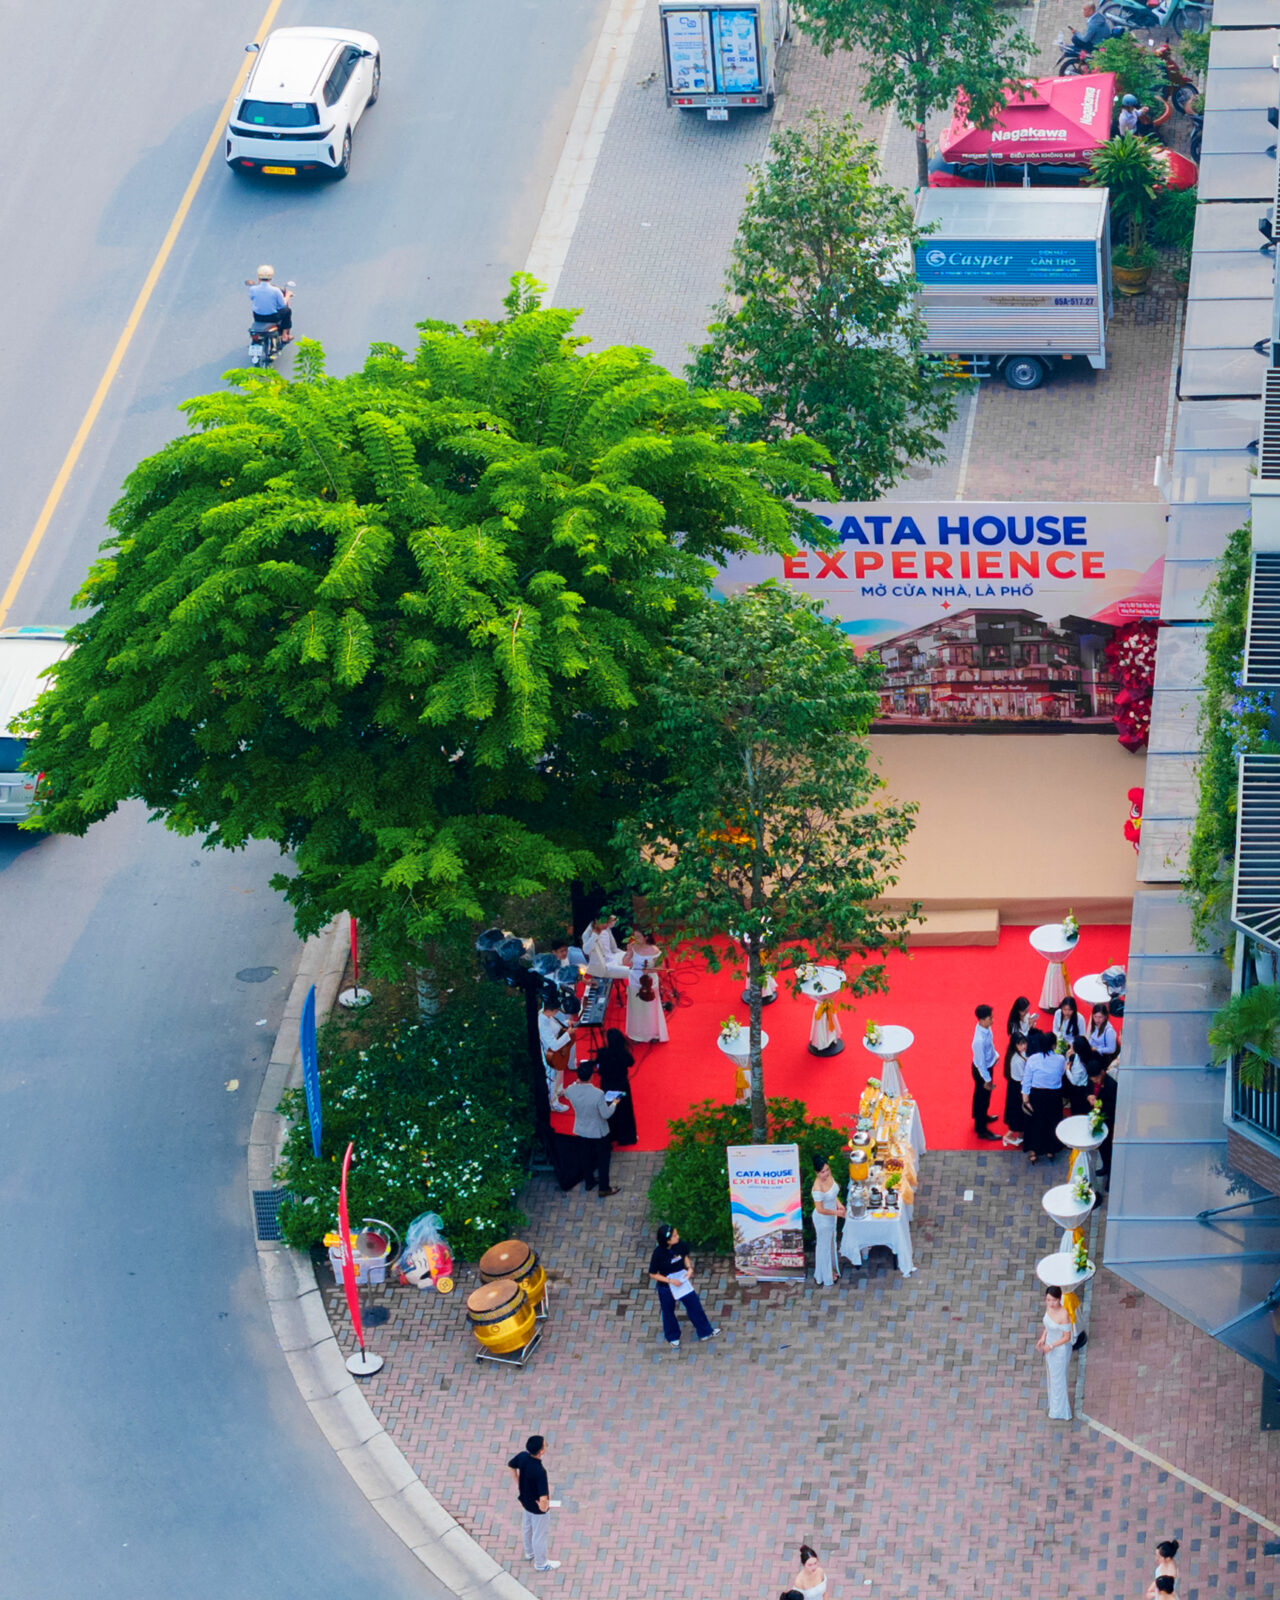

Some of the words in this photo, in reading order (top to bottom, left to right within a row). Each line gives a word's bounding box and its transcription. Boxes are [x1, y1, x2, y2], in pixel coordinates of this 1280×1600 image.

[991, 127, 1067, 142] Nagakawa
[949, 252, 1013, 268] Casper
[938, 515, 1087, 545] HOUSE
[783, 551, 1106, 579] EXPERIENCE
[861, 583, 888, 597] MỞ
[892, 583, 927, 597] CỬA
[932, 584, 971, 598] NHÀ,
[976, 584, 996, 597] LÀ
[1000, 583, 1035, 597] PHỐ
[732, 1177, 796, 1185] EXPERIENCE
[735, 1170, 761, 1178] CATA
[763, 1169, 793, 1178] HOUSE
